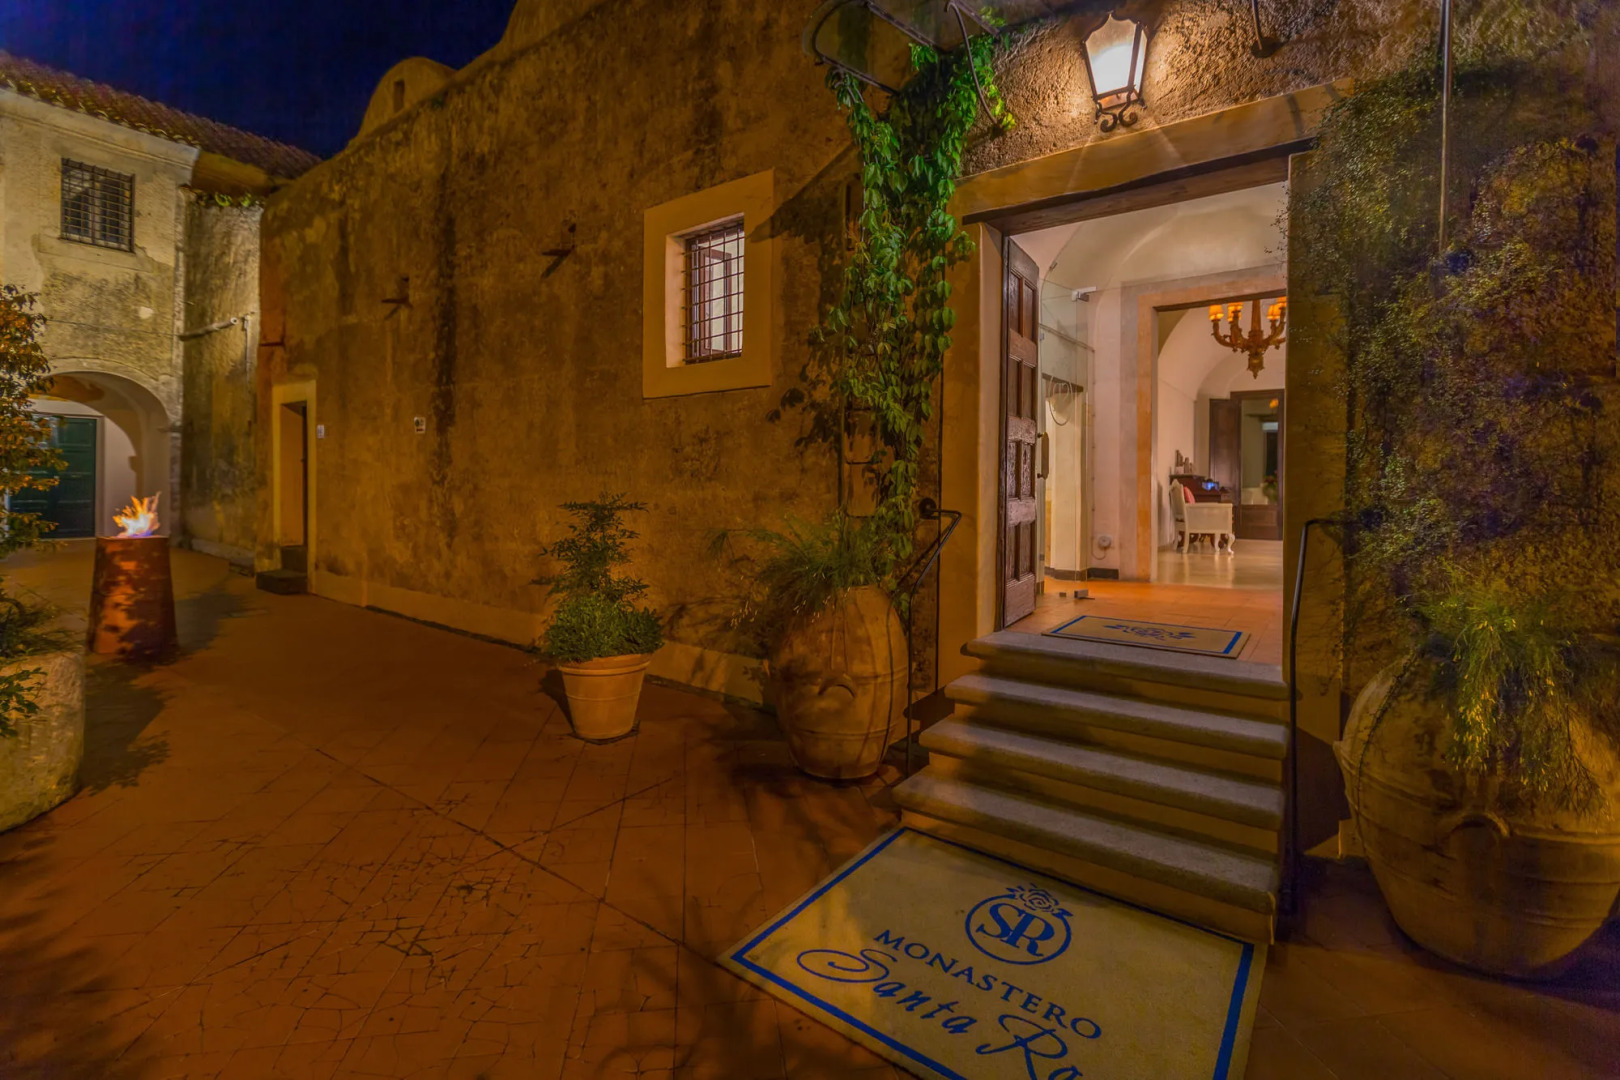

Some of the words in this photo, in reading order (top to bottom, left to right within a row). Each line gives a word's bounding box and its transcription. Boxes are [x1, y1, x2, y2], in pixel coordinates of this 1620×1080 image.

[976, 903, 1055, 957] SR
[796, 949, 977, 1034] Santa
[873, 929, 1102, 1039] MONASTERO
